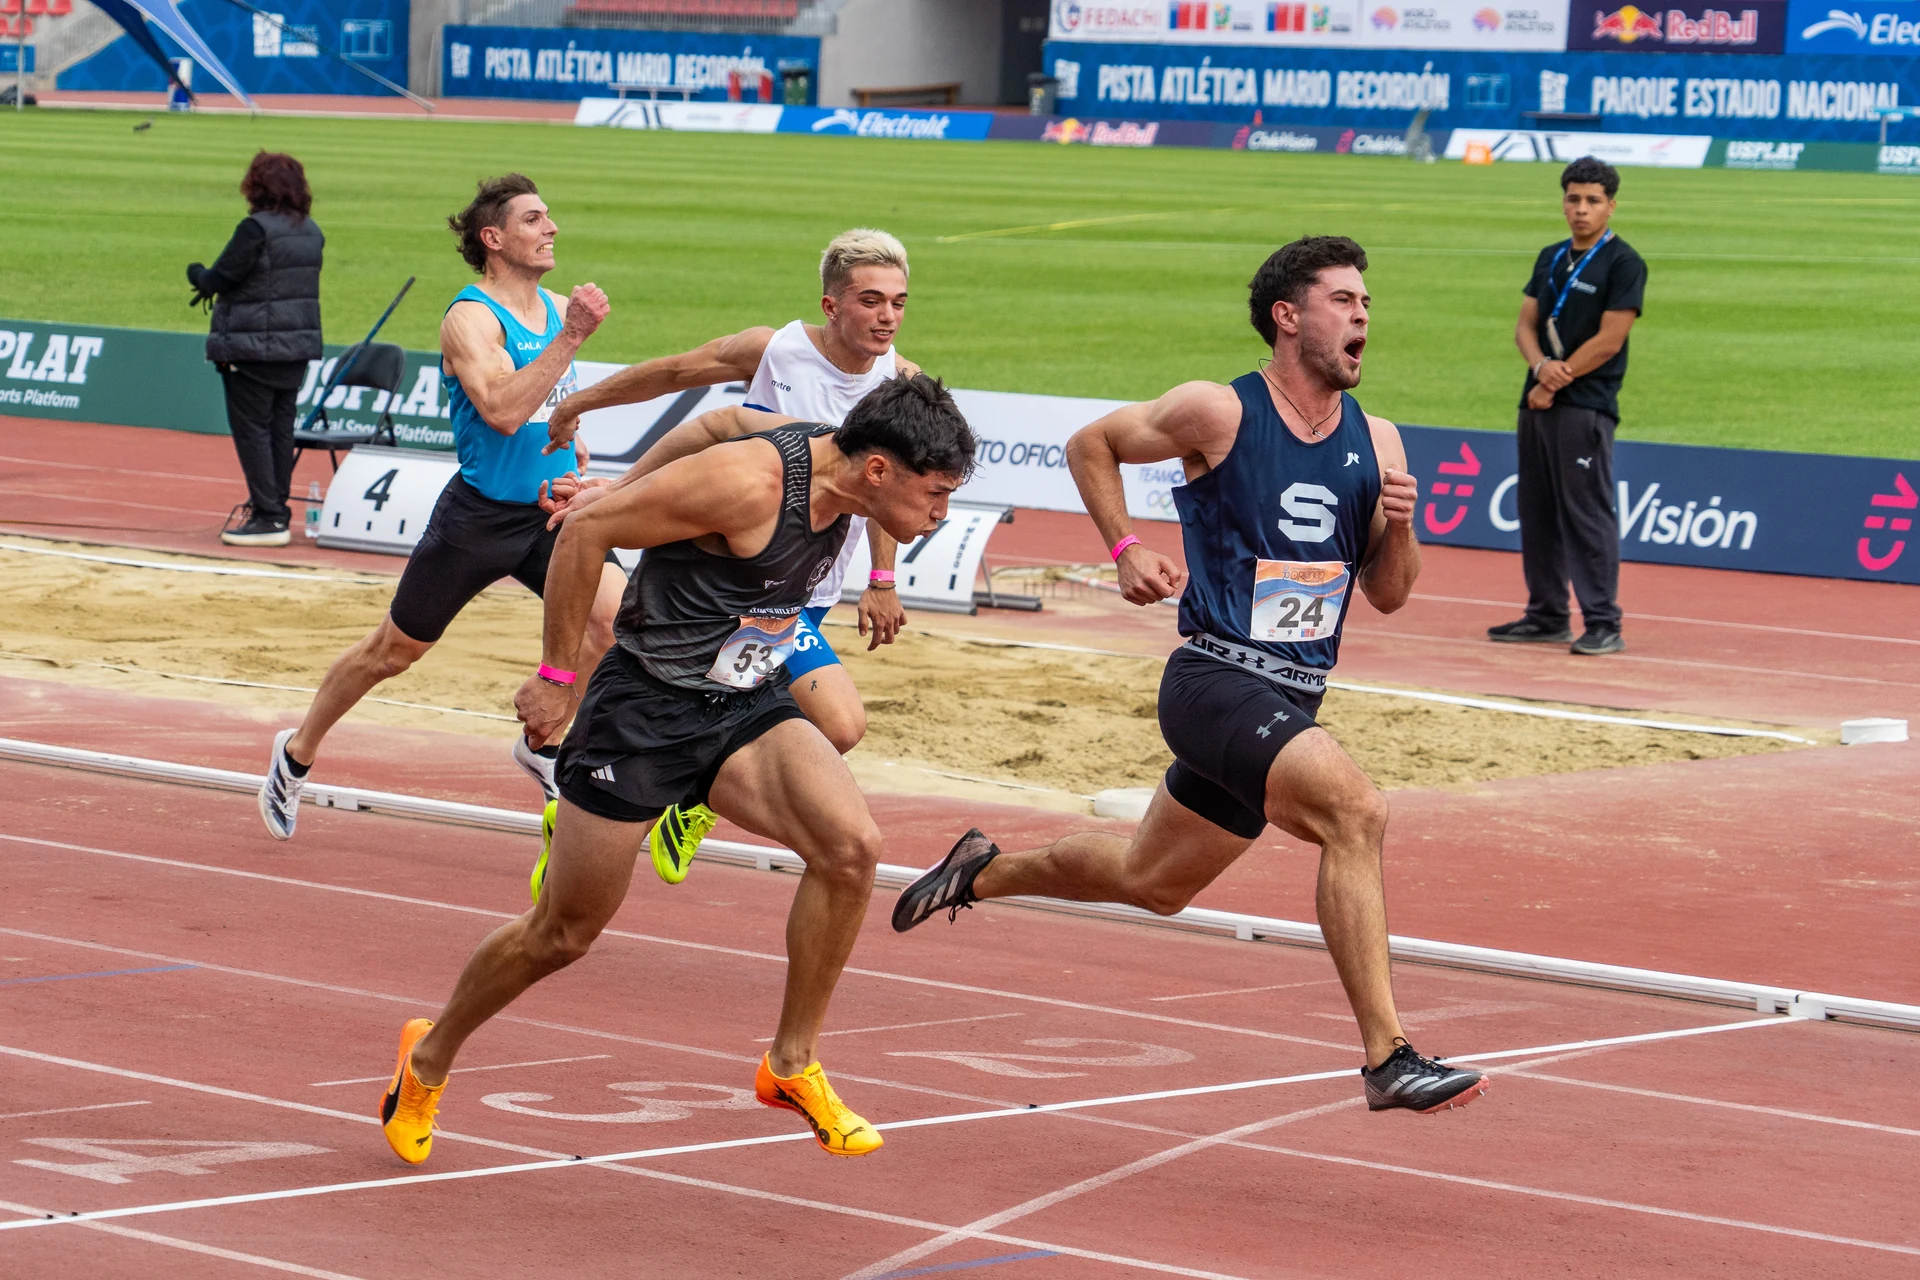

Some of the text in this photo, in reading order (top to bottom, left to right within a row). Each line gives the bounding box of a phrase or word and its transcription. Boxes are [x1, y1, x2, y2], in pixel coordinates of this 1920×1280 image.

[1085, 8, 1161, 27] FEDACHI
[485, 47, 531, 80] PISTA
[535, 41, 612, 84] ATLÉTICA
[617, 51, 671, 87] MARIO
[1098, 56, 1450, 111] PISTA ATLÉTICA MARIO RECORDÓN
[1591, 76, 1904, 122] PARQUE ESTADIO NACIONAL
[1726, 140, 1805, 162] USPLAT
[23, 388, 80, 409] Platform
[771, 379, 792, 392] mitre
[1009, 442, 1068, 469] OFICI
[363, 468, 399, 511] 4
[1278, 482, 1339, 543] S
[1276, 597, 1324, 628] 24
[733, 643, 774, 675] 53
[884, 1036, 1196, 1079] 2
[480, 1079, 766, 1124] 3
[12, 1137, 337, 1185] 4
